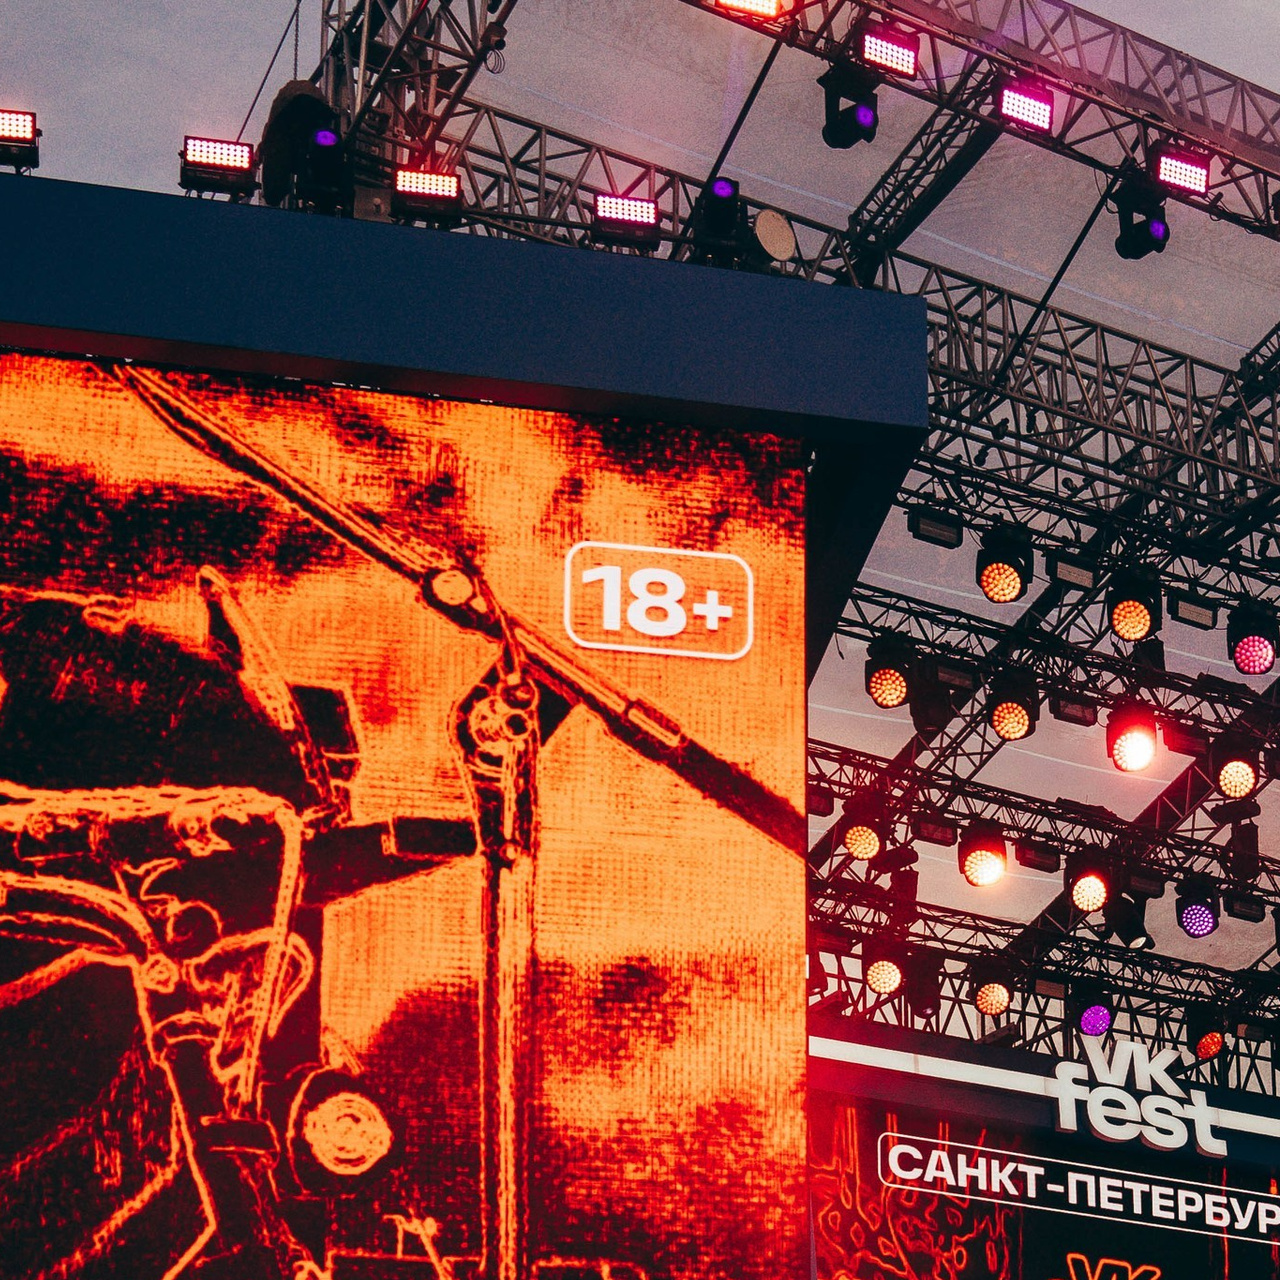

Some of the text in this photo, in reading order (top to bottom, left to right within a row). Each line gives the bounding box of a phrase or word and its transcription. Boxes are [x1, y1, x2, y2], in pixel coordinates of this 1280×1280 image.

[582, 565, 734, 637] 18+
[1080, 1033, 1188, 1098] VK
[1050, 1061, 1228, 1157] fest
